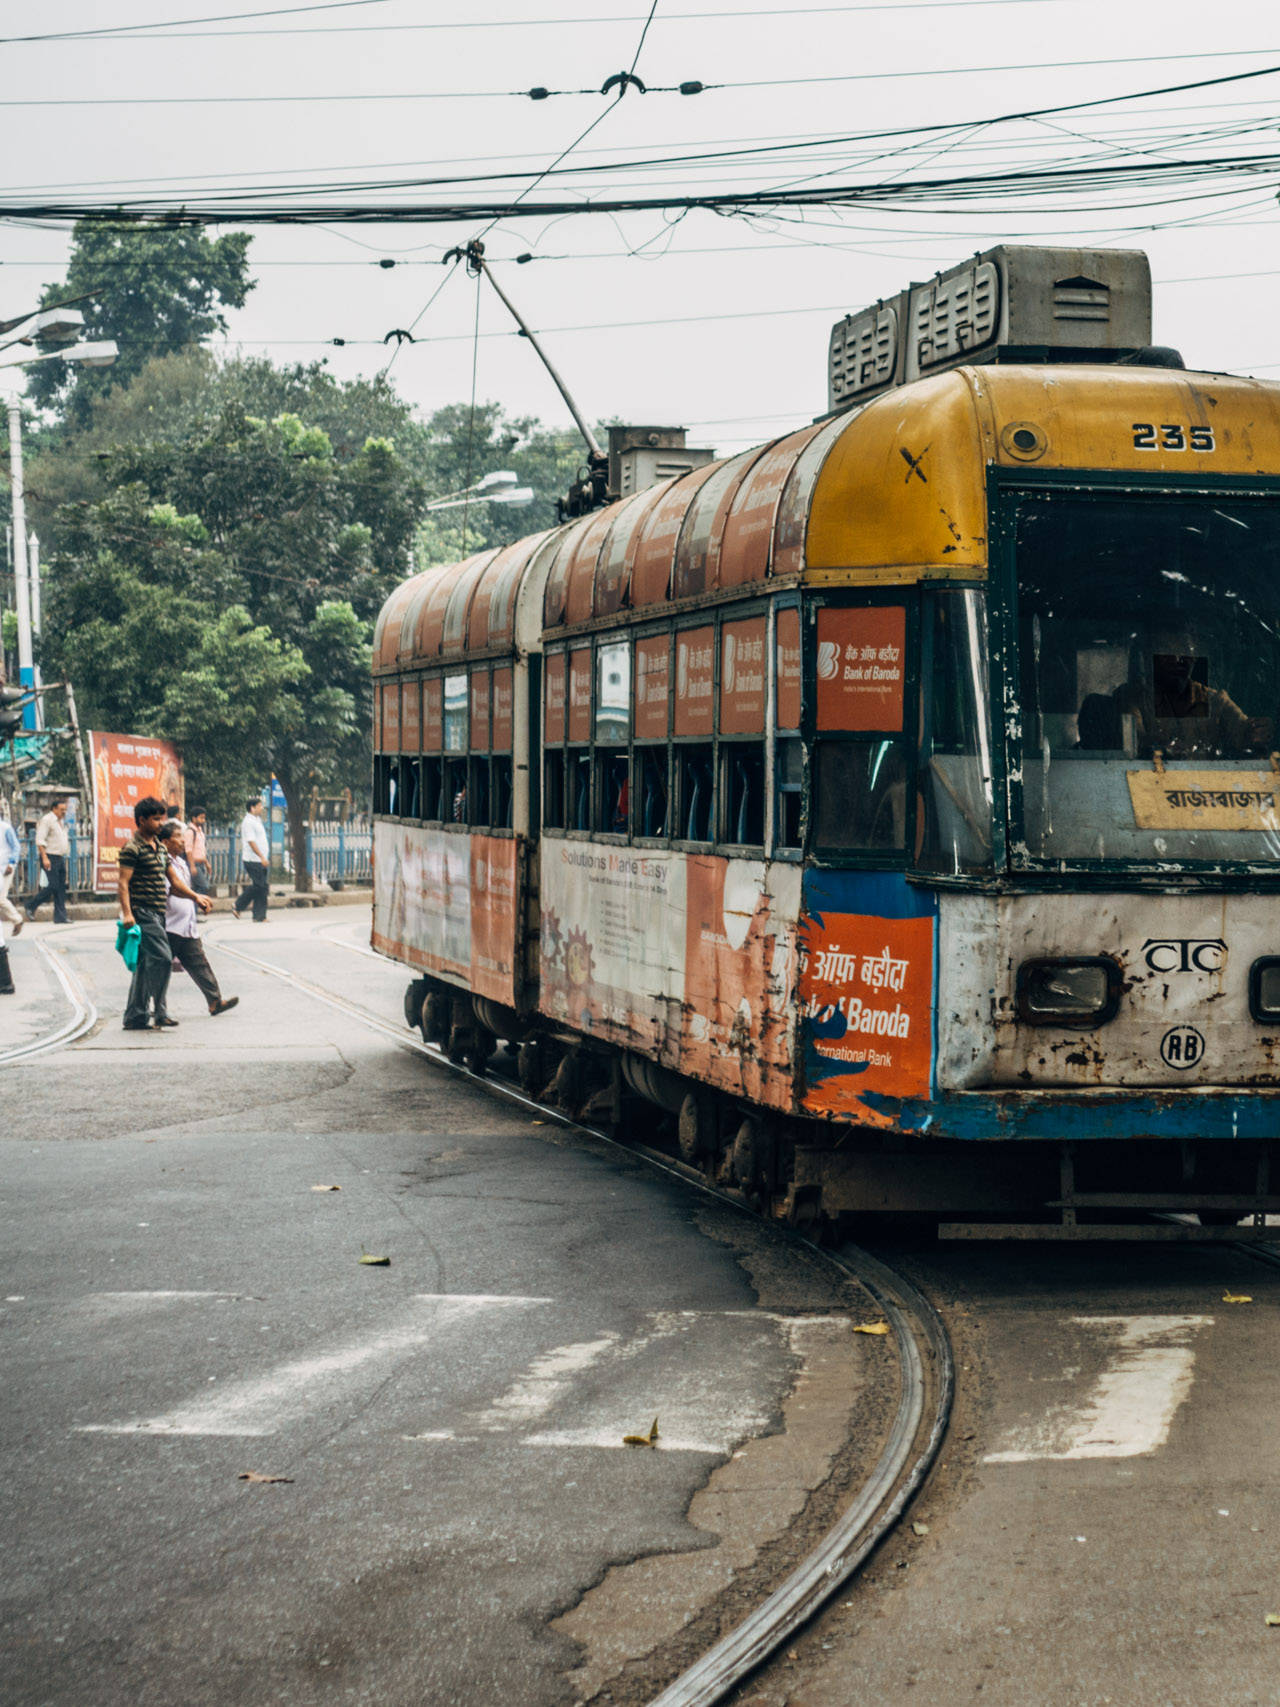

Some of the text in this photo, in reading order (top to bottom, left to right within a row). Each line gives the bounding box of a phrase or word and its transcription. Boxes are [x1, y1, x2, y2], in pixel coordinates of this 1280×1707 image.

[1132, 423, 1216, 452] 235
[843, 665, 900, 680] Bank of Baroda
[560, 848, 668, 883] Solutions Made Easy
[860, 945, 910, 994] बड़ौदा
[1140, 938, 1229, 973] CTC
[846, 996, 911, 1039] Baroda
[814, 1042, 893, 1067] ternational Bank
